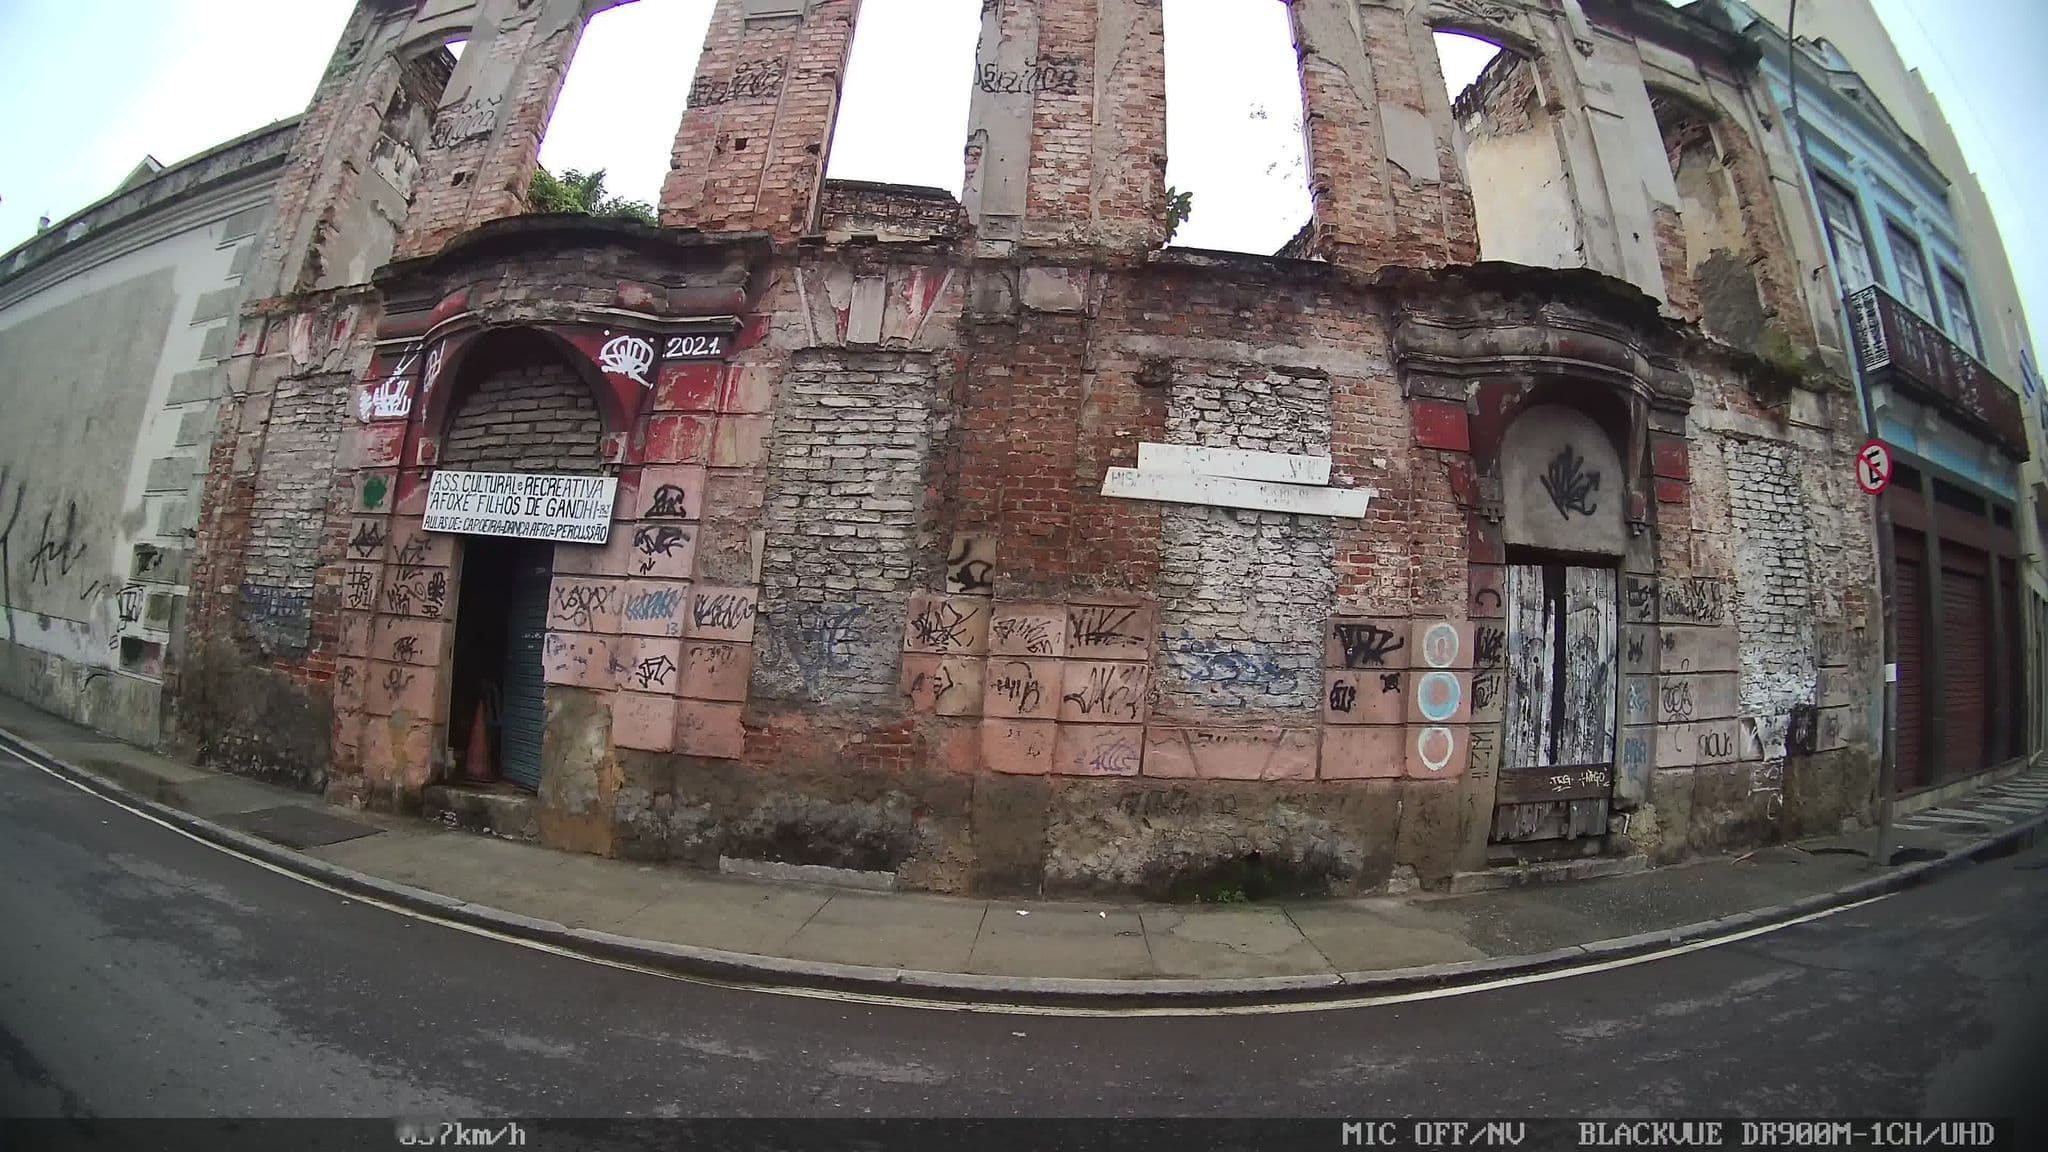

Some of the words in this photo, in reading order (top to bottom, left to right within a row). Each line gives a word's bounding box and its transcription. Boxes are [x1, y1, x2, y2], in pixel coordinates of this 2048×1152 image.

[462, 474, 517, 495] CULTURAL
[524, 476, 604, 499] RECREATIVA
[476, 495, 521, 516] FILHOS
[525, 497, 543, 516] DE
[424, 515, 449, 529] AULAS
